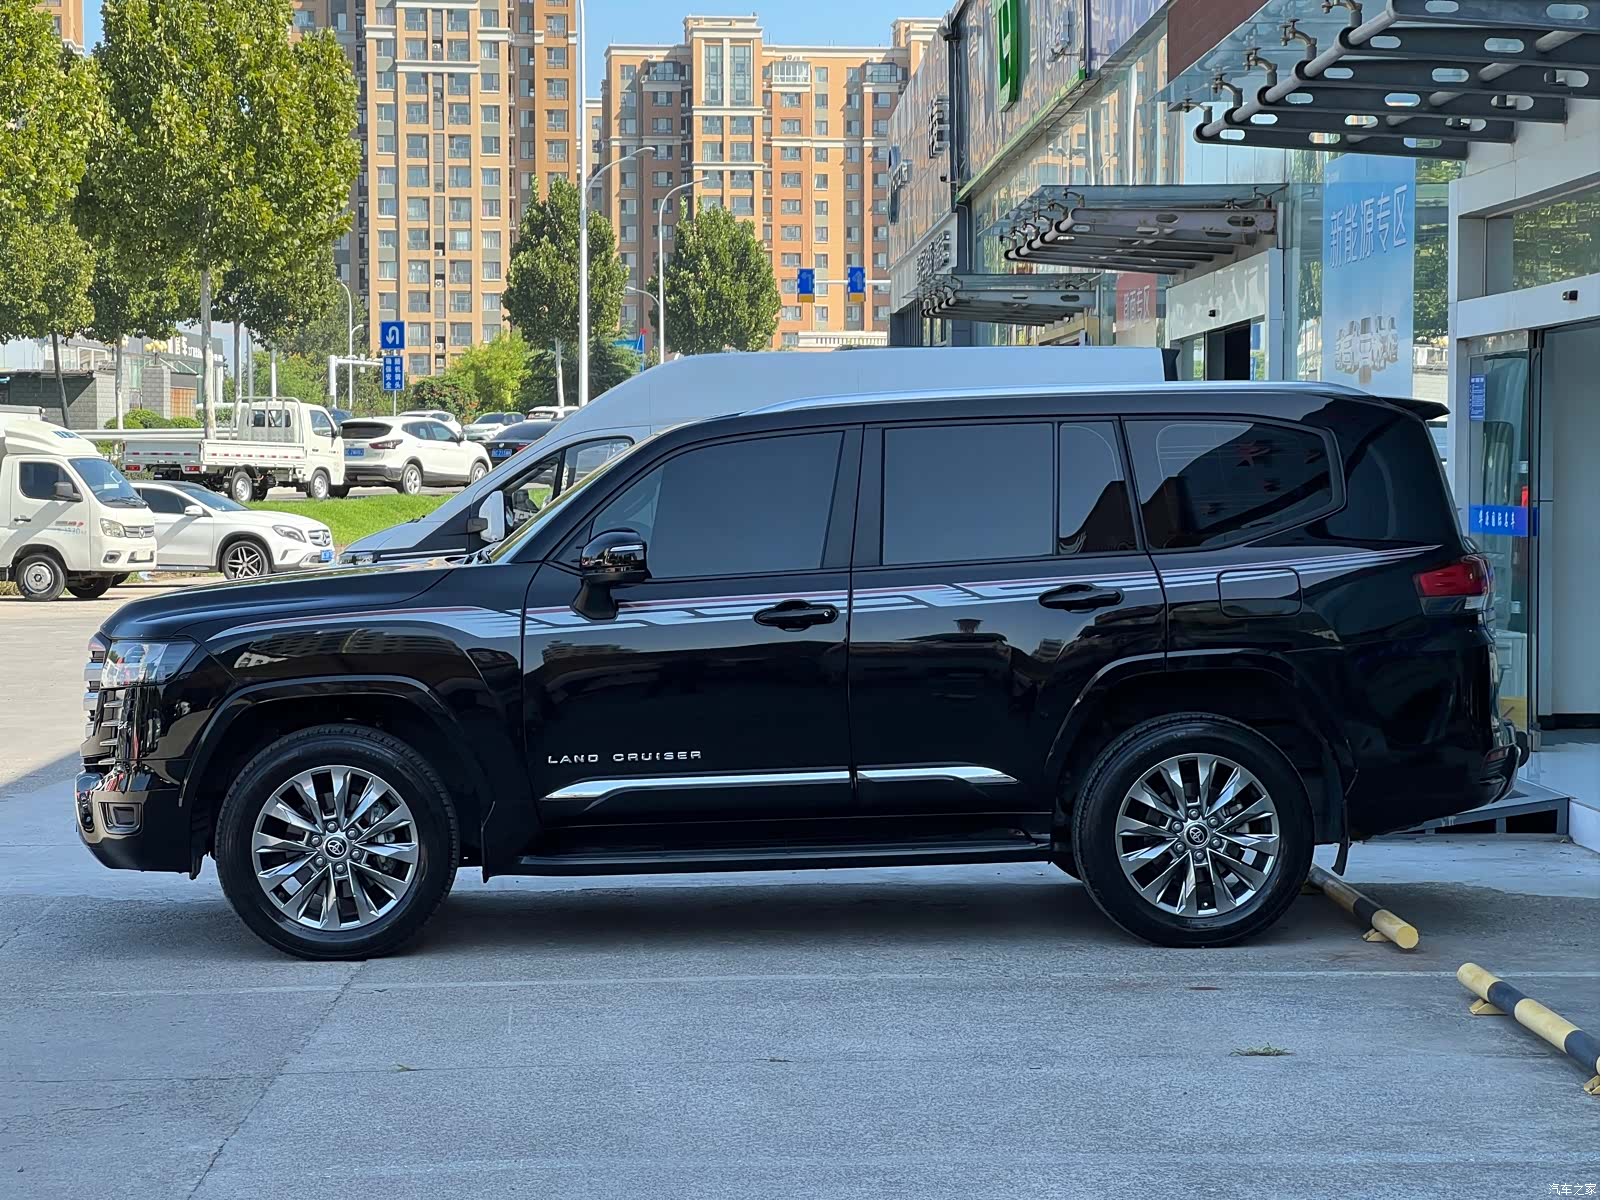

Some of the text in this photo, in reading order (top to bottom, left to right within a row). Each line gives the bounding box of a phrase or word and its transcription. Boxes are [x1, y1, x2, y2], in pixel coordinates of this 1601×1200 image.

[1330, 184, 1408, 268] 新能源专区
[547, 750, 702, 764] LAND CRUISER
